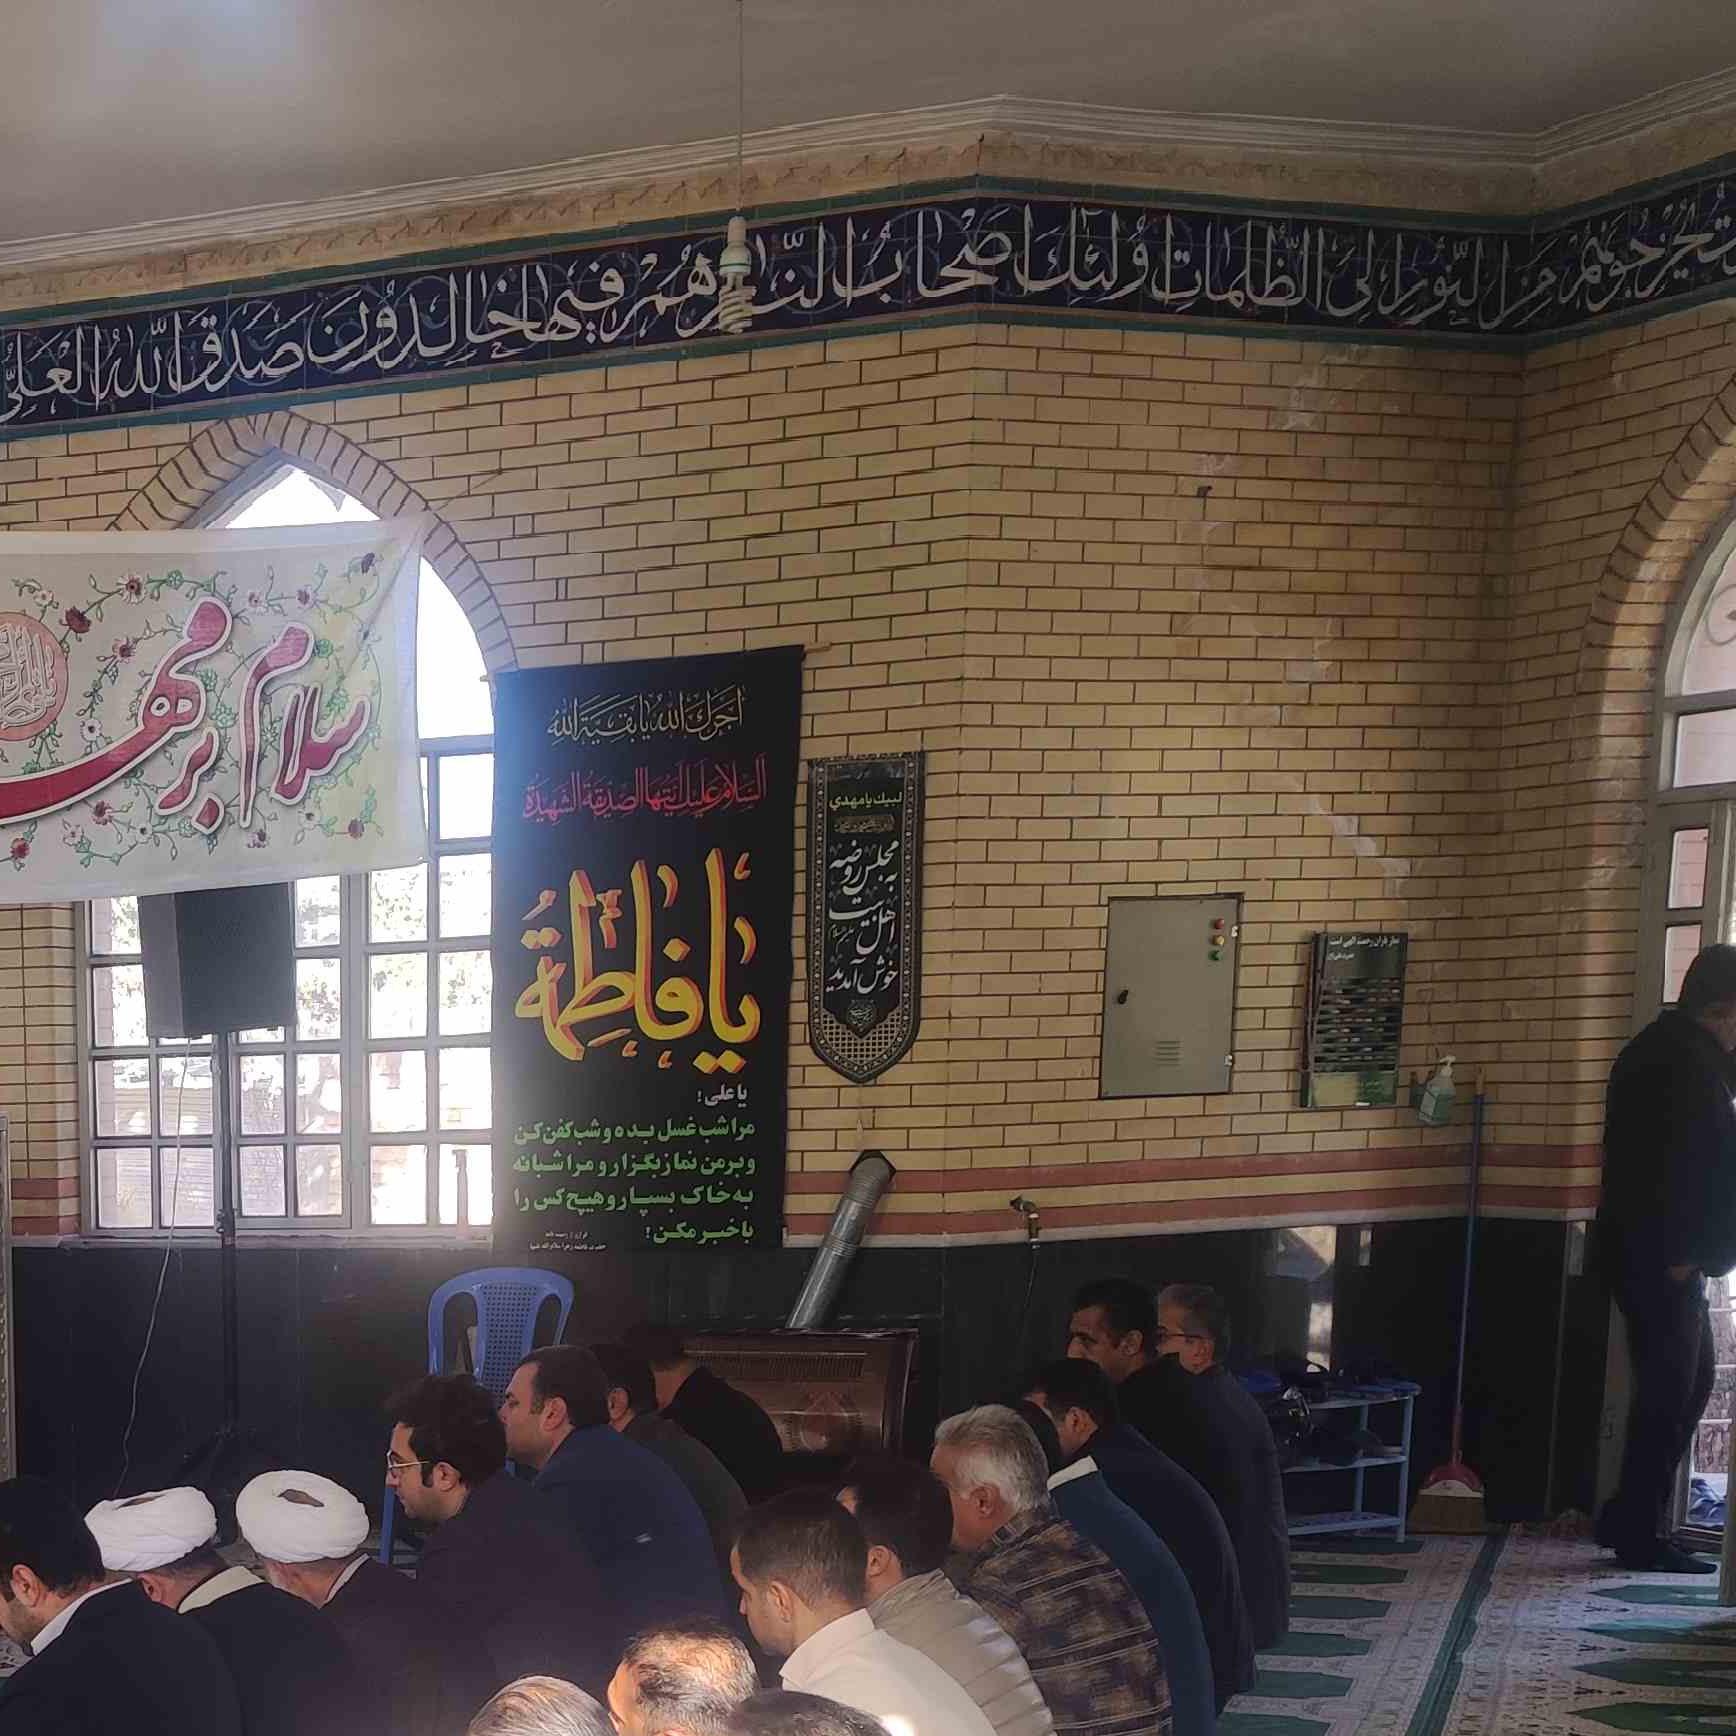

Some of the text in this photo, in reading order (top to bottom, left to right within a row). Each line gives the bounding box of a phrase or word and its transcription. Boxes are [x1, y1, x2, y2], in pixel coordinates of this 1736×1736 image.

[676, 216, 856, 337] النر
[833, 201, 1033, 304] اصحاب
[1151, 213, 1324, 311] الظلمات
[306, 268, 540, 369] خالدون
[522, 264, 624, 345] فیها
[98, 311, 183, 400] الله
[169, 316, 304, 393] صدق
[239, 622, 372, 828] سلام
[546, 696, 578, 744] الله
[638, 693, 650, 741] یا
[650, 691, 684, 733] الله
[158, 729, 225, 834] بر
[828, 840, 862, 884] روضه
[842, 839, 900, 896] مجلس
[692, 848, 762, 1074] یا
[825, 954, 899, 994] خوش آمدید
[704, 1083, 748, 1108] یا علی
[513, 1115, 755, 1146] مرا شب غسل بده و شب کفن کن
[513, 1149, 756, 1179] و بر من نماز بگزار و مرا شبانه
[513, 1180, 754, 1217] به خاک بسپار و هیچ کس را
[653, 1217, 754, 1245] با خبر مکن
